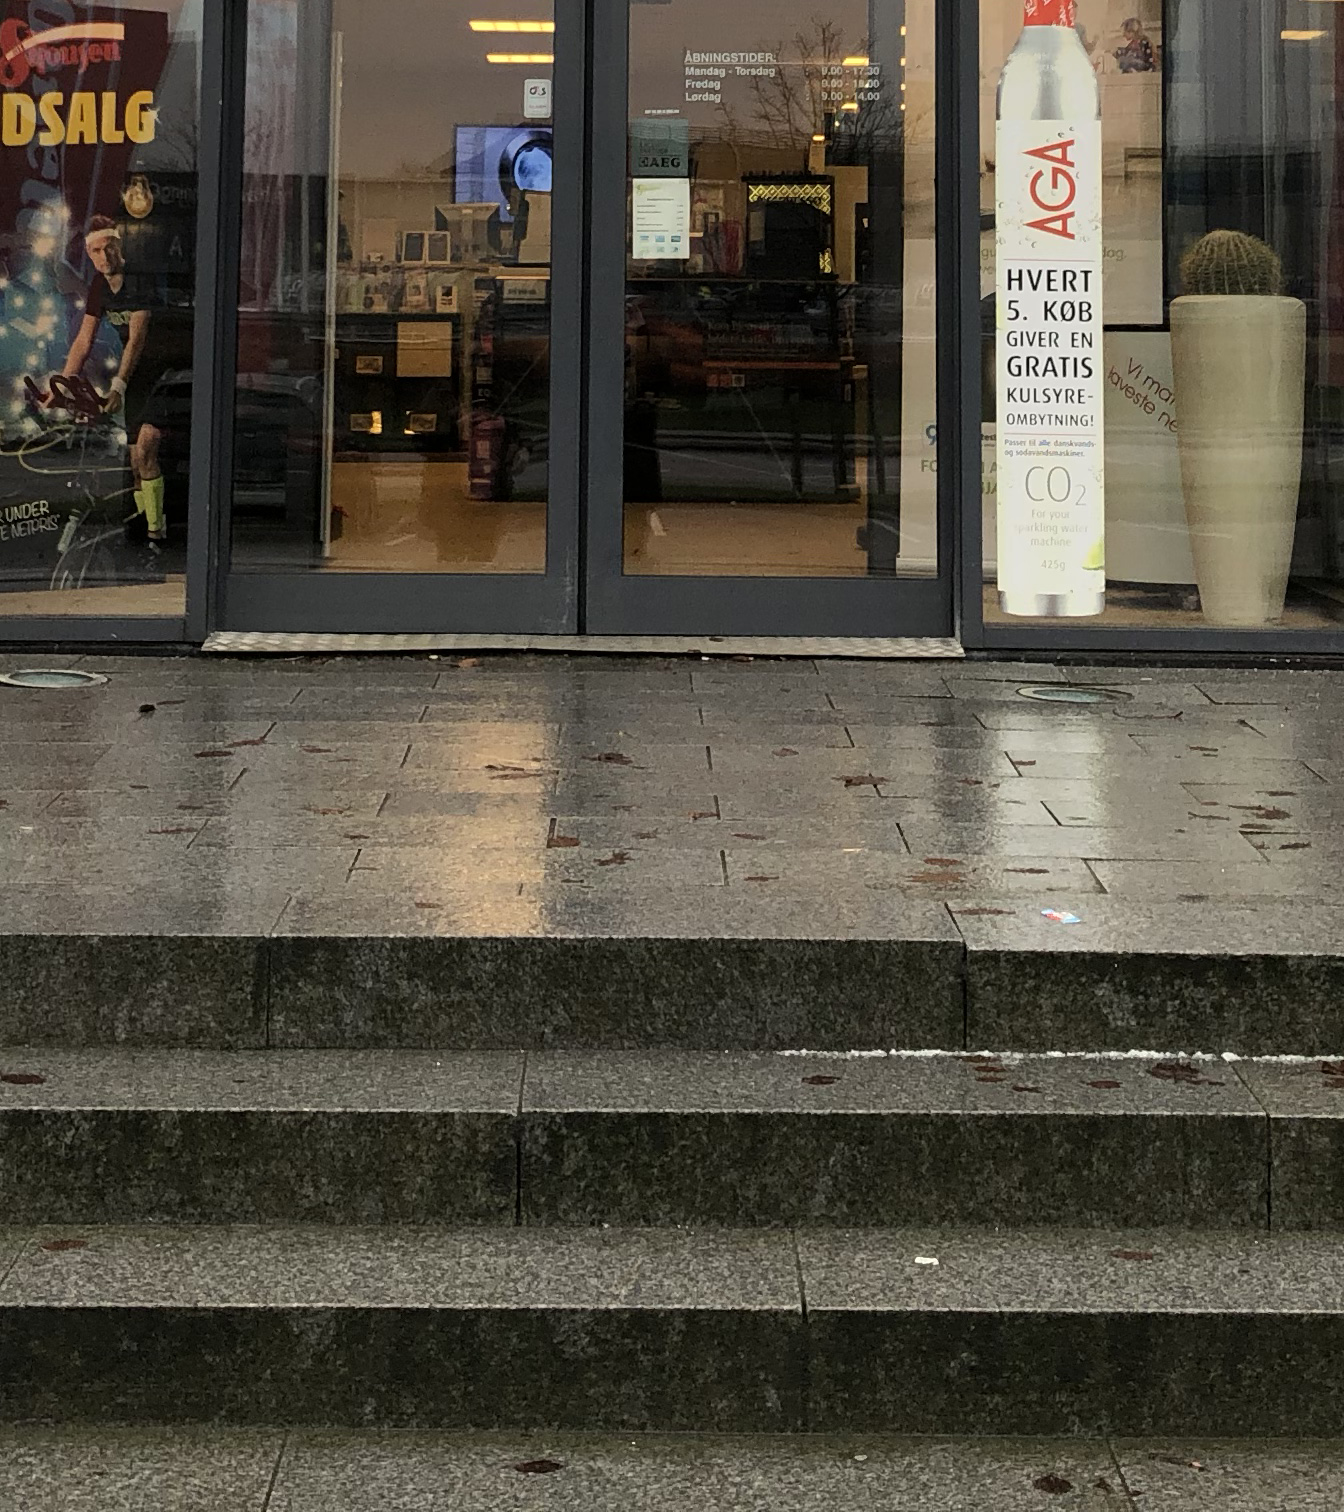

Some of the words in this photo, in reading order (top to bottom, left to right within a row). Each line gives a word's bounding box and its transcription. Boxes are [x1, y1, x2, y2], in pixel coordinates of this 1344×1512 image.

[685, 66, 726, 77] Mandag
[735, 66, 776, 77] Torsdag
[685, 79, 721, 90] Fredag
[685, 92, 721, 103] Lørdag
[821, 92, 843, 101] 9.00
[854, 92, 880, 101] 14.00
[650, 157, 681, 168] AEG
[1021, 139, 1076, 240] AGA
[1007, 269, 1093, 292] HVERT
[1007, 300, 1028, 321] 5.
[1044, 300, 1093, 323] KØB
[1007, 331, 1060, 348] GIVER
[1071, 332, 1094, 348] EN
[1007, 356, 1094, 379] GRATIS
[1126, 357, 1145, 379] Vi
[1007, 388, 1094, 404] KULSYRE-
[1107, 365, 1156, 415] laveste
[1006, 413, 1095, 427] OMBYTNING!
[1004, 438, 1027, 447] Passer
[1039, 439, 1051, 447] alle
[1004, 450, 1014, 458] og
[4, 500, 50, 523] UNDER
[1031, 509, 1045, 519] For
[1049, 511, 1070, 521] your
[1030, 536, 1071, 547] machine
[1041, 559, 1066, 572] 425g
